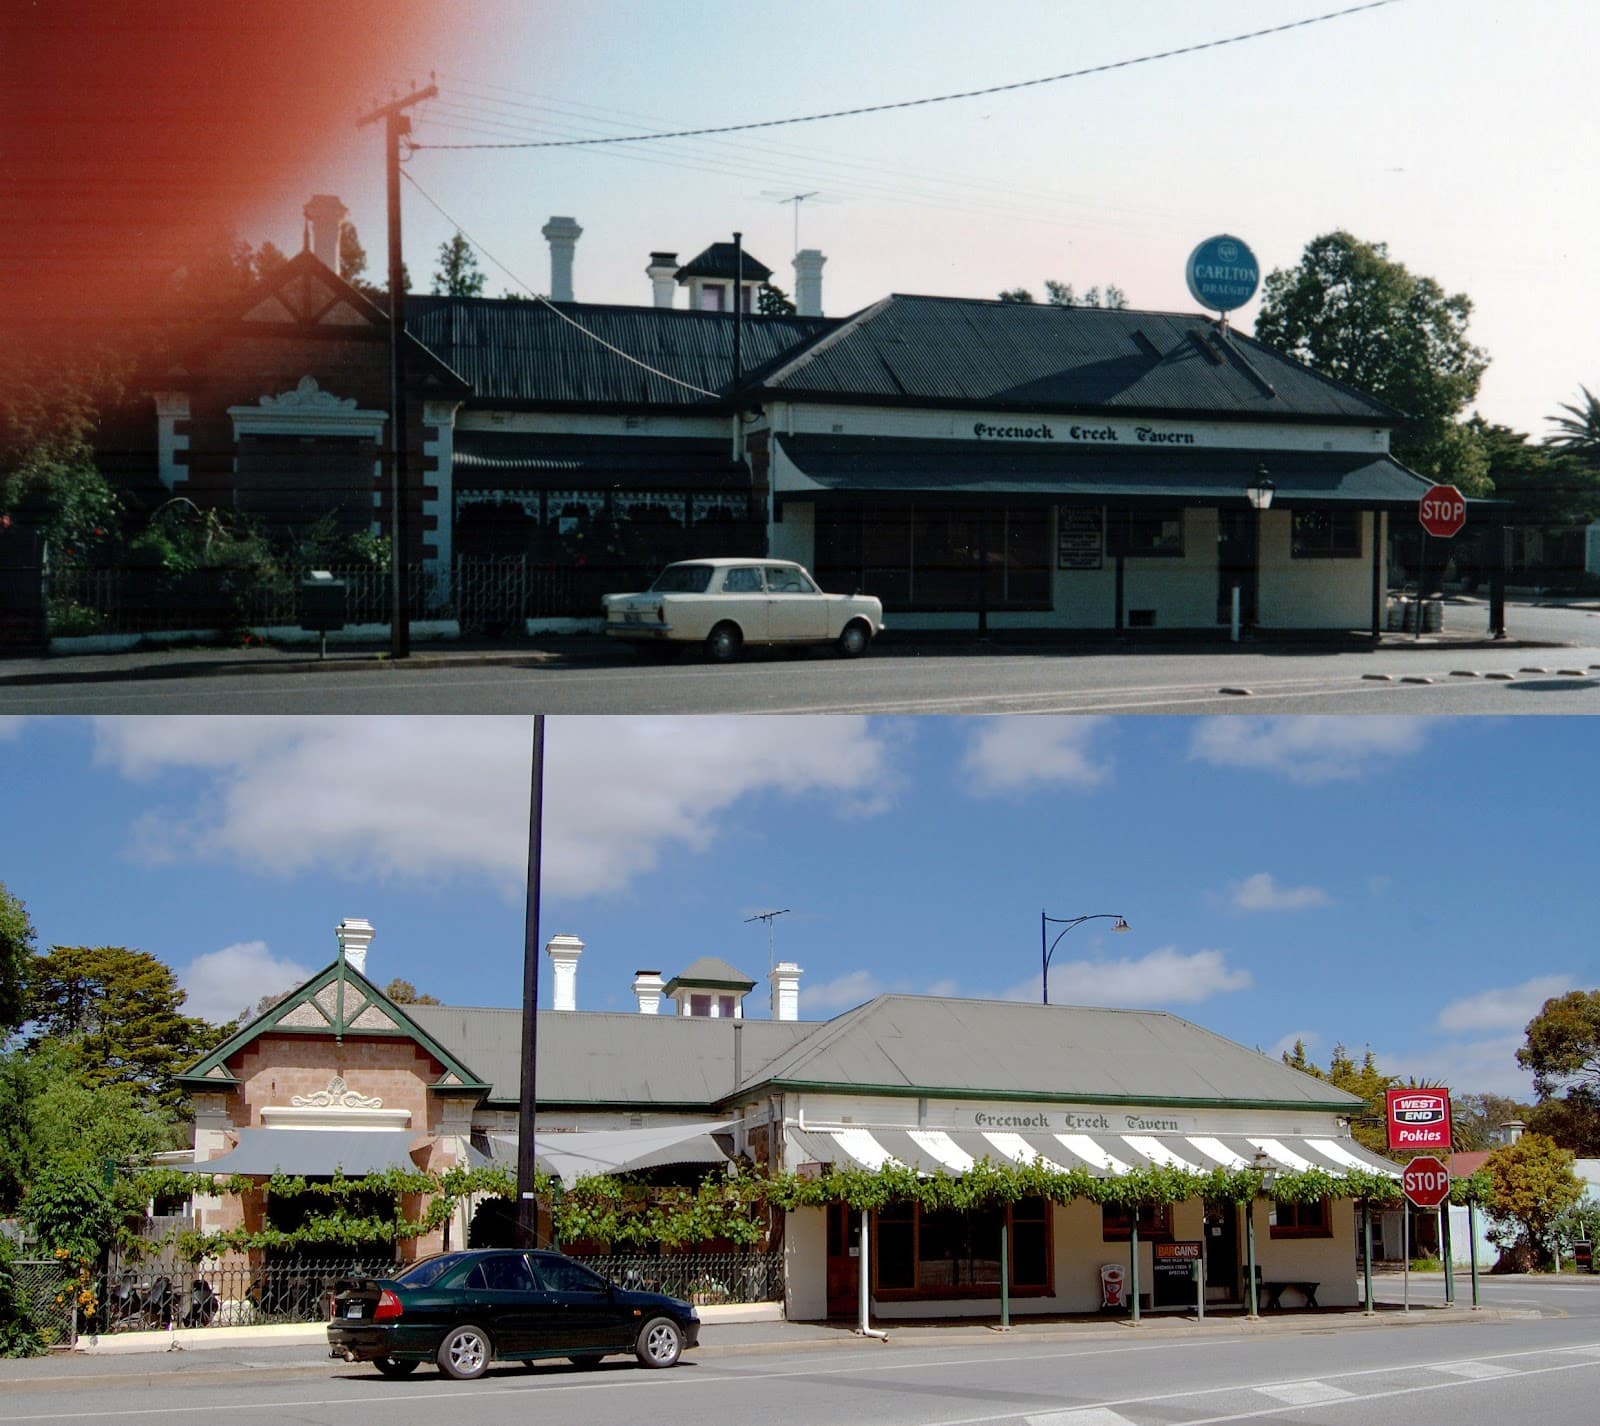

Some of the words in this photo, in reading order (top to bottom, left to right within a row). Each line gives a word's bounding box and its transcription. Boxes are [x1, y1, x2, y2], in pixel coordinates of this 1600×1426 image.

[1195, 265, 1257, 282] CARLTON
[1202, 283, 1250, 296] DRAUGHT
[973, 422, 1054, 440] Greenock
[1069, 425, 1118, 441] Creek
[1135, 426, 1195, 444] Tavern
[1422, 500, 1464, 521] STOP
[1400, 1099, 1437, 1109] WEST
[974, 1111, 1050, 1127] Greenock
[1065, 1112, 1110, 1129] Creek
[1124, 1114, 1178, 1130] Tavern
[1404, 1111, 1433, 1121] END
[1399, 1129, 1441, 1142] Pokies
[1405, 1172, 1447, 1191] STOP
[1158, 1245, 1199, 1257] BARGAINS
